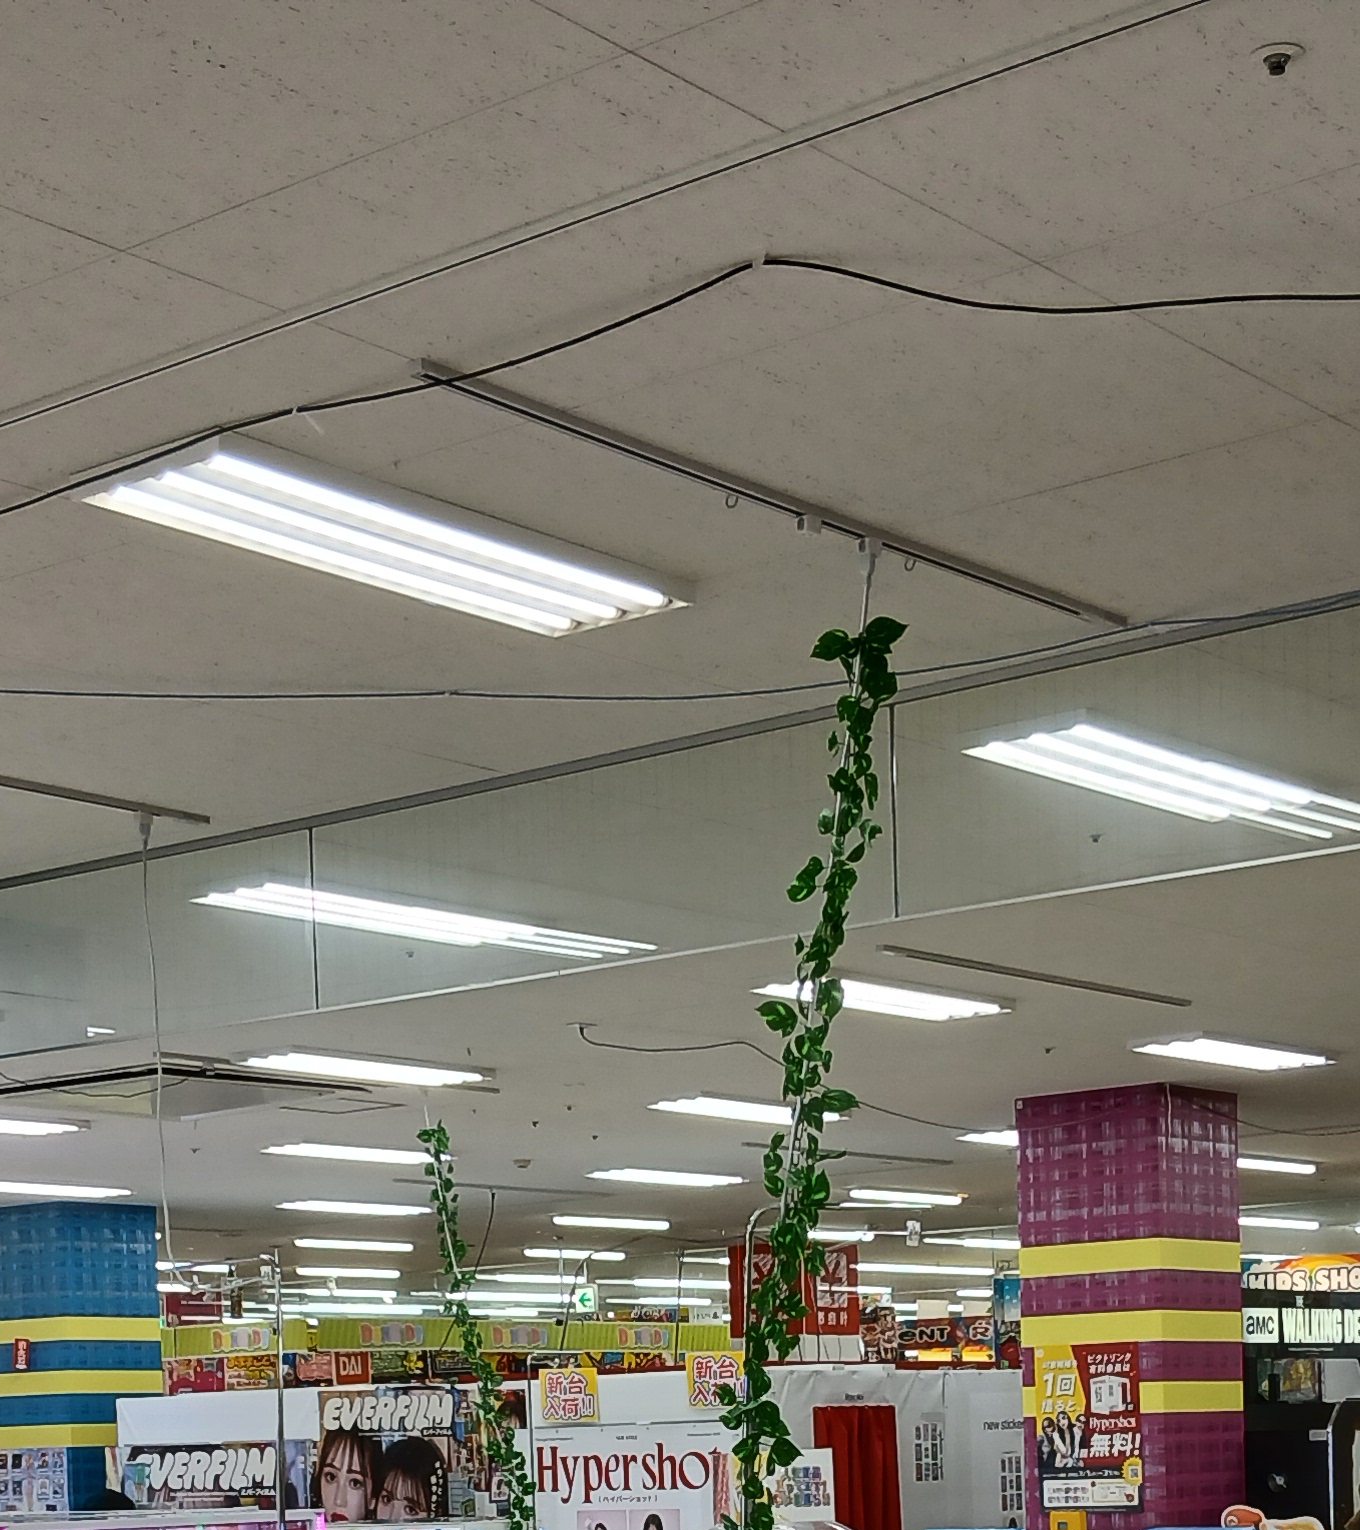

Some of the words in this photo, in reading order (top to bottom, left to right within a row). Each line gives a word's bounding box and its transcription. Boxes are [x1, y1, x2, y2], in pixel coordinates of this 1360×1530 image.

[1281, 1307, 1342, 1344] WALKING
[694, 1355, 739, 1381] 新台
[546, 1372, 587, 1396] 新台
[323, 1392, 453, 1433] EVERFILM
